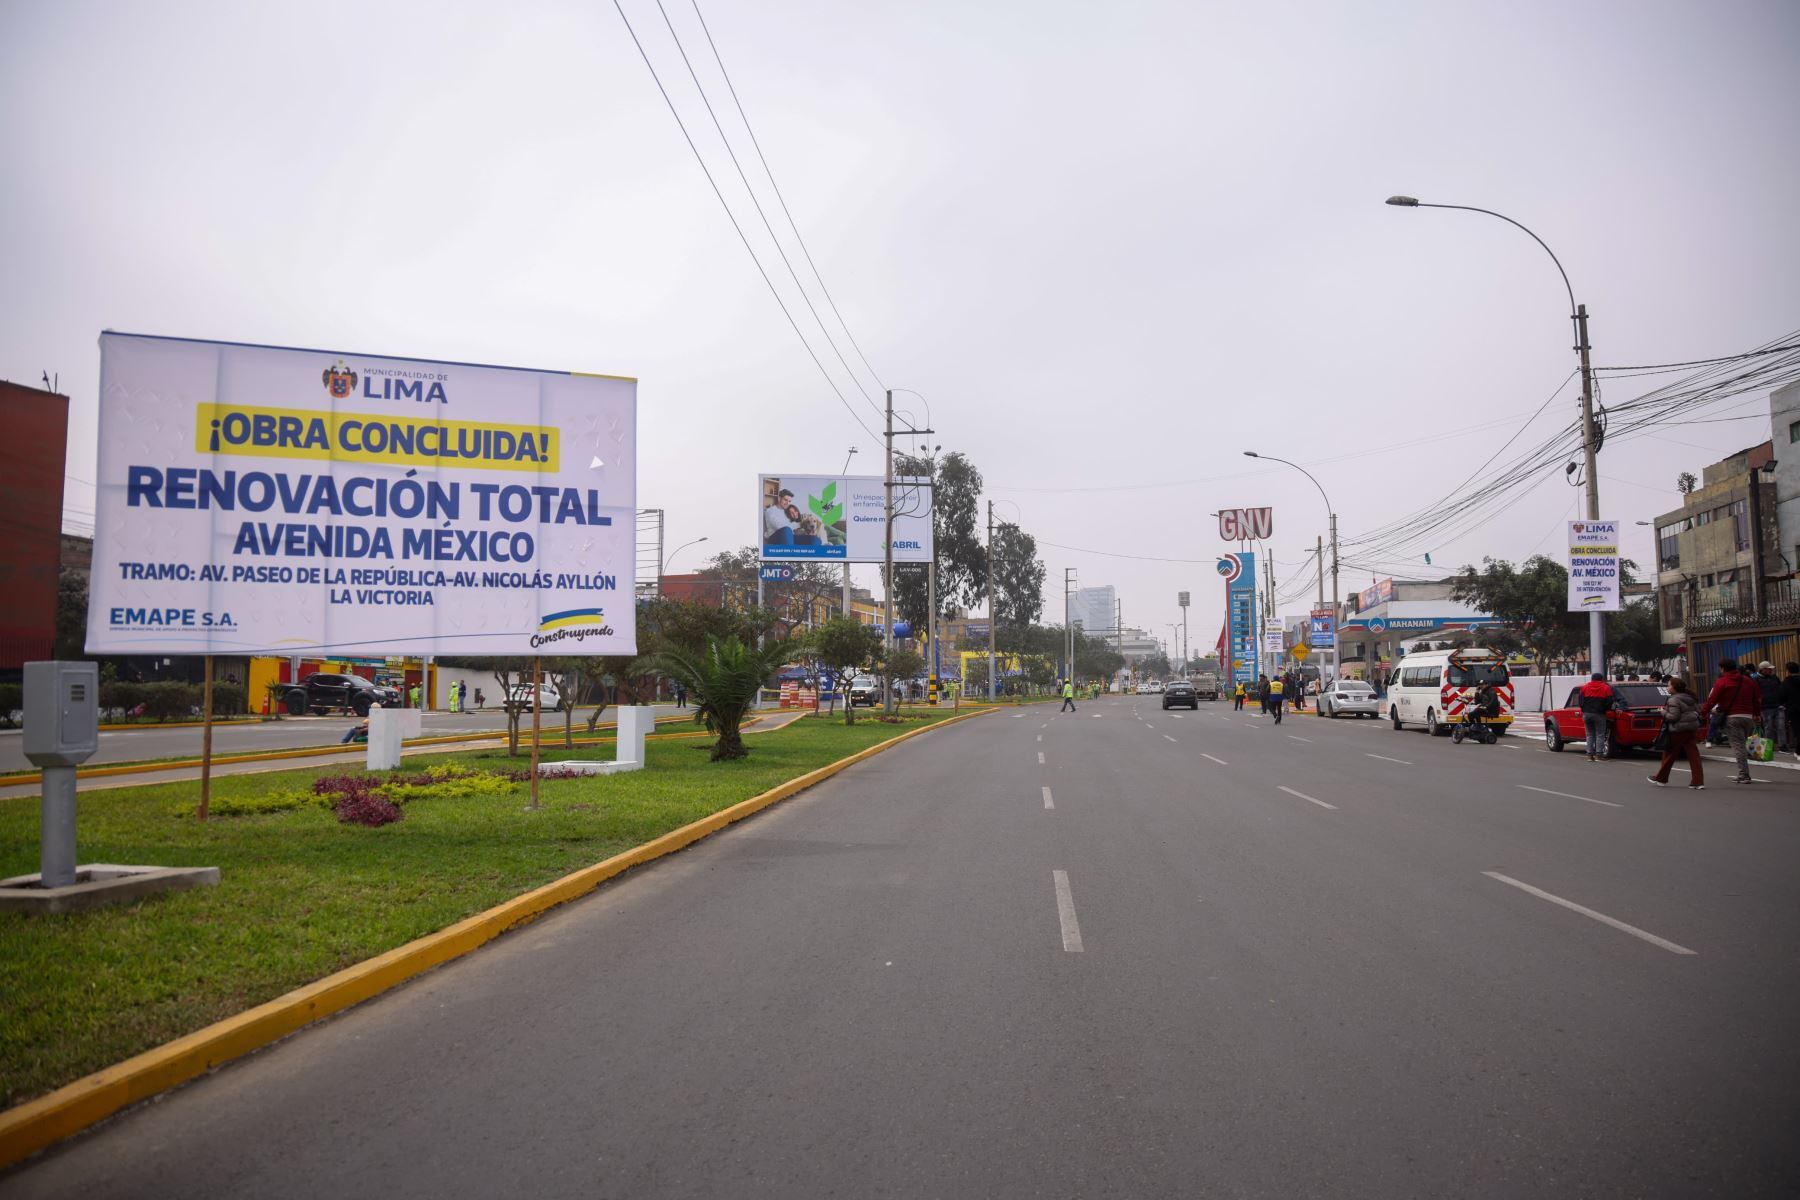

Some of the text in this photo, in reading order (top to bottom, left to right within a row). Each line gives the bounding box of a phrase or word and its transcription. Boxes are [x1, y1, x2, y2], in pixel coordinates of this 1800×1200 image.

[363, 368, 435, 380] MUNICIPALIDAD
[363, 376, 449, 404] LIMA
[209, 412, 549, 463] ¡OBRA CONCLUIDA!
[127, 465, 612, 527] RENOVACIÓN TOTAL
[1219, 507, 1273, 541] GNV
[232, 520, 535, 563] AVENIDA MÉXICO
[892, 541, 921, 549] ABRIL
[1572, 557, 1615, 566] RENOVACIÓN
[1572, 567, 1615, 577] AV. MÉXICO
[119, 562, 196, 581] TRAMO:
[199, 564, 228, 582] AV.
[232, 565, 293, 583] PASEO
[296, 567, 321, 584] DE
[324, 568, 346, 585] LA
[482, 569, 553, 589] NICOLÁS
[556, 571, 616, 590] AYLLÓN
[330, 589, 434, 606] LA VICTORIA
[110, 607, 238, 626] EMAPE S.A.
[1389, 620, 1434, 628] MAHANAIM
[530, 625, 614, 648] Construyendo
